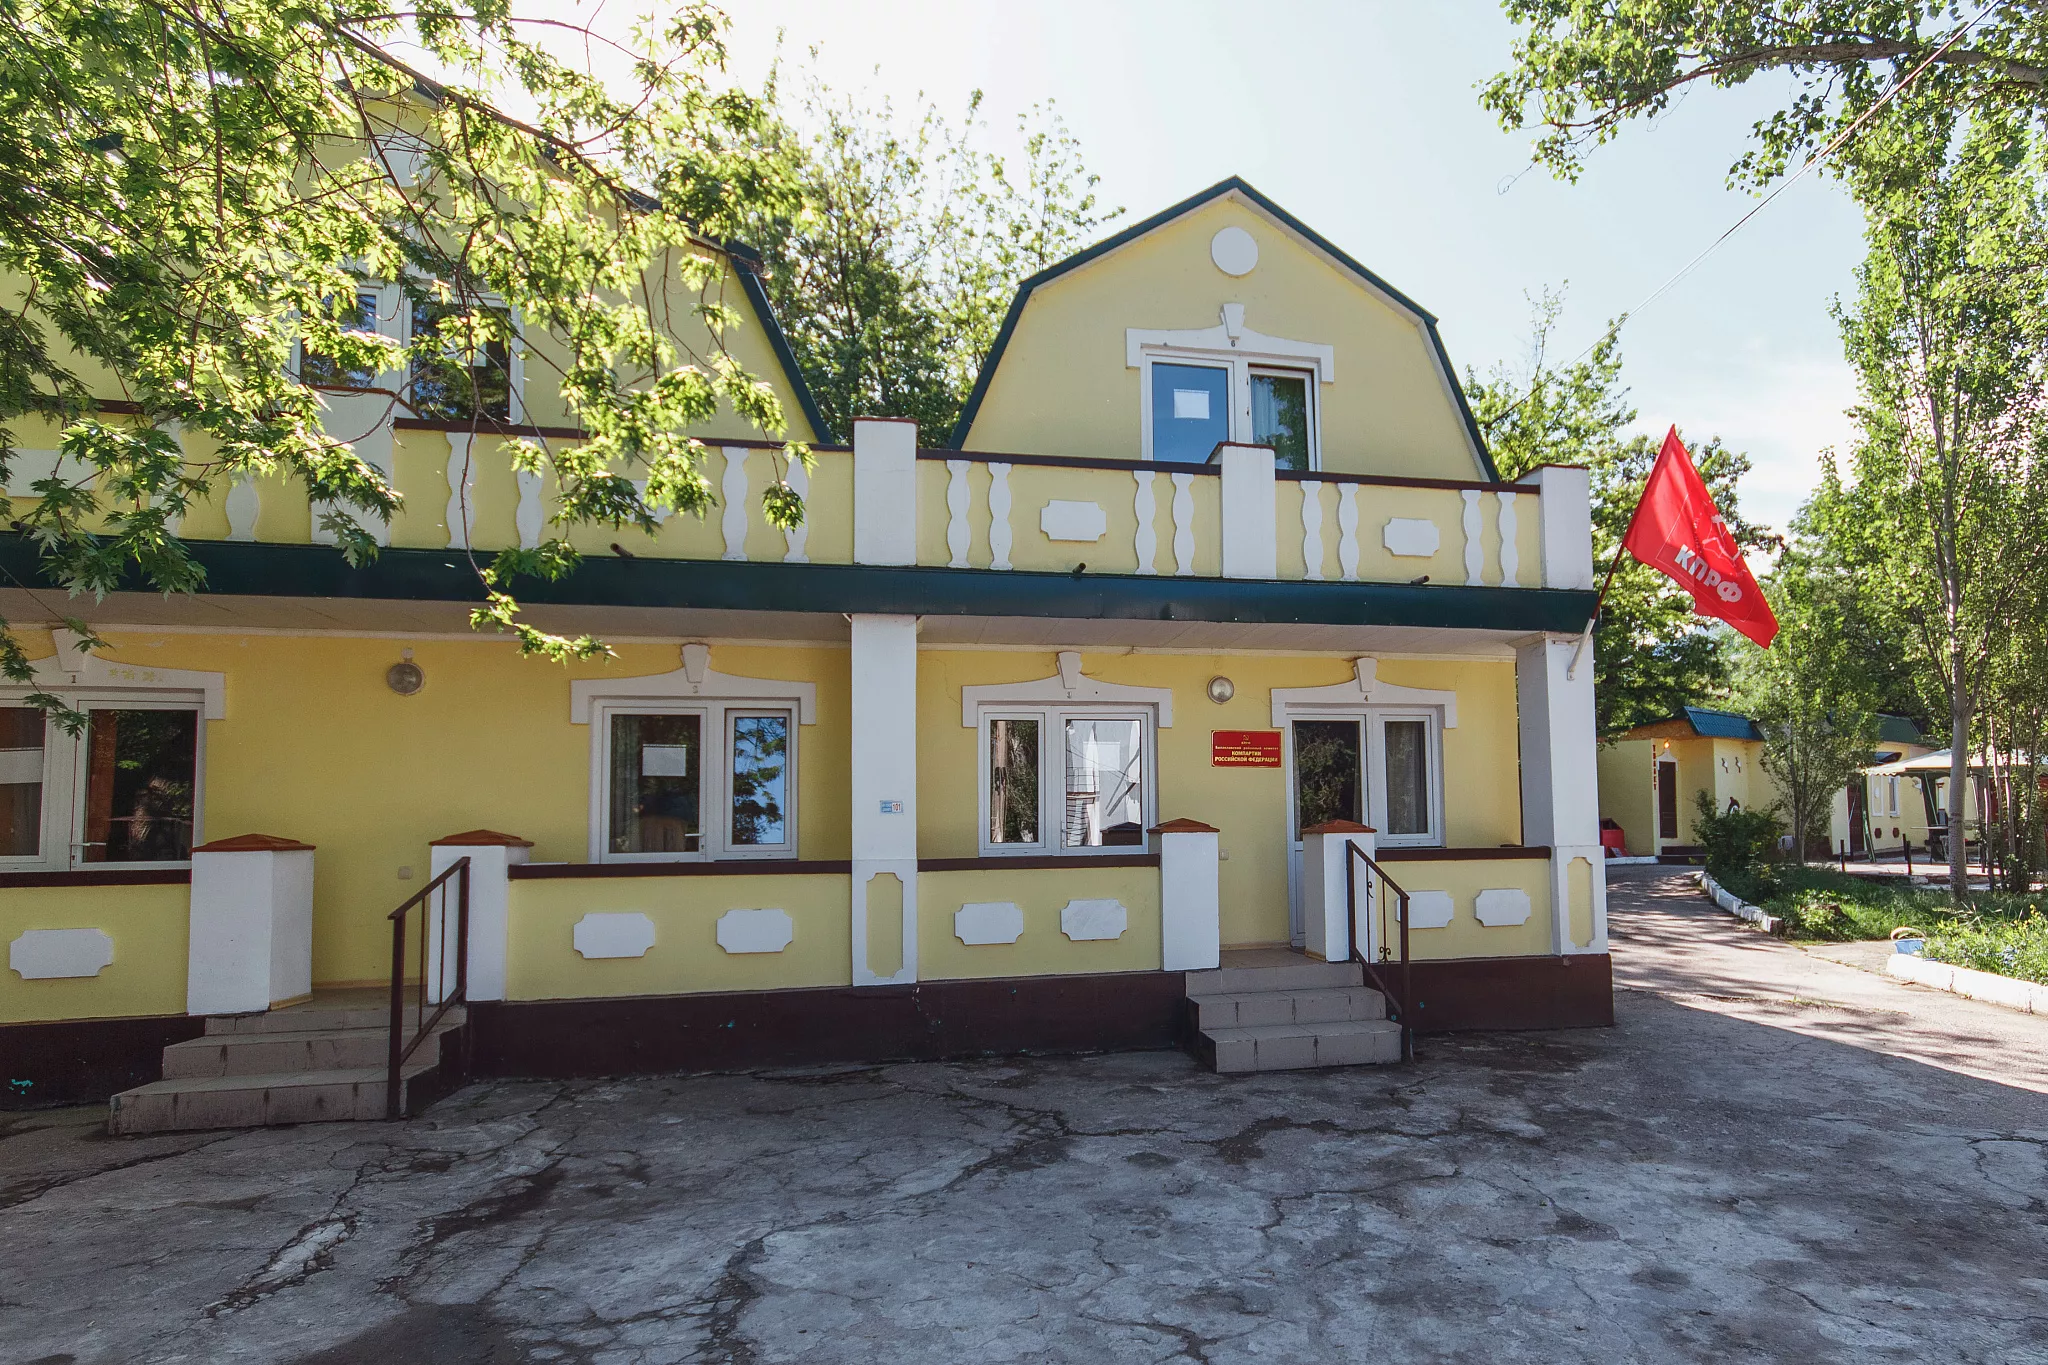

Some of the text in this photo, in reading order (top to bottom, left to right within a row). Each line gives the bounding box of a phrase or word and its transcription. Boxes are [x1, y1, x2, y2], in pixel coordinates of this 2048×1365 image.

[1230, 339, 1236, 348] 6
[1674, 543, 1743, 603] КПРФ
[71, 674, 77, 684] 1
[1363, 694, 1369, 702] 4
